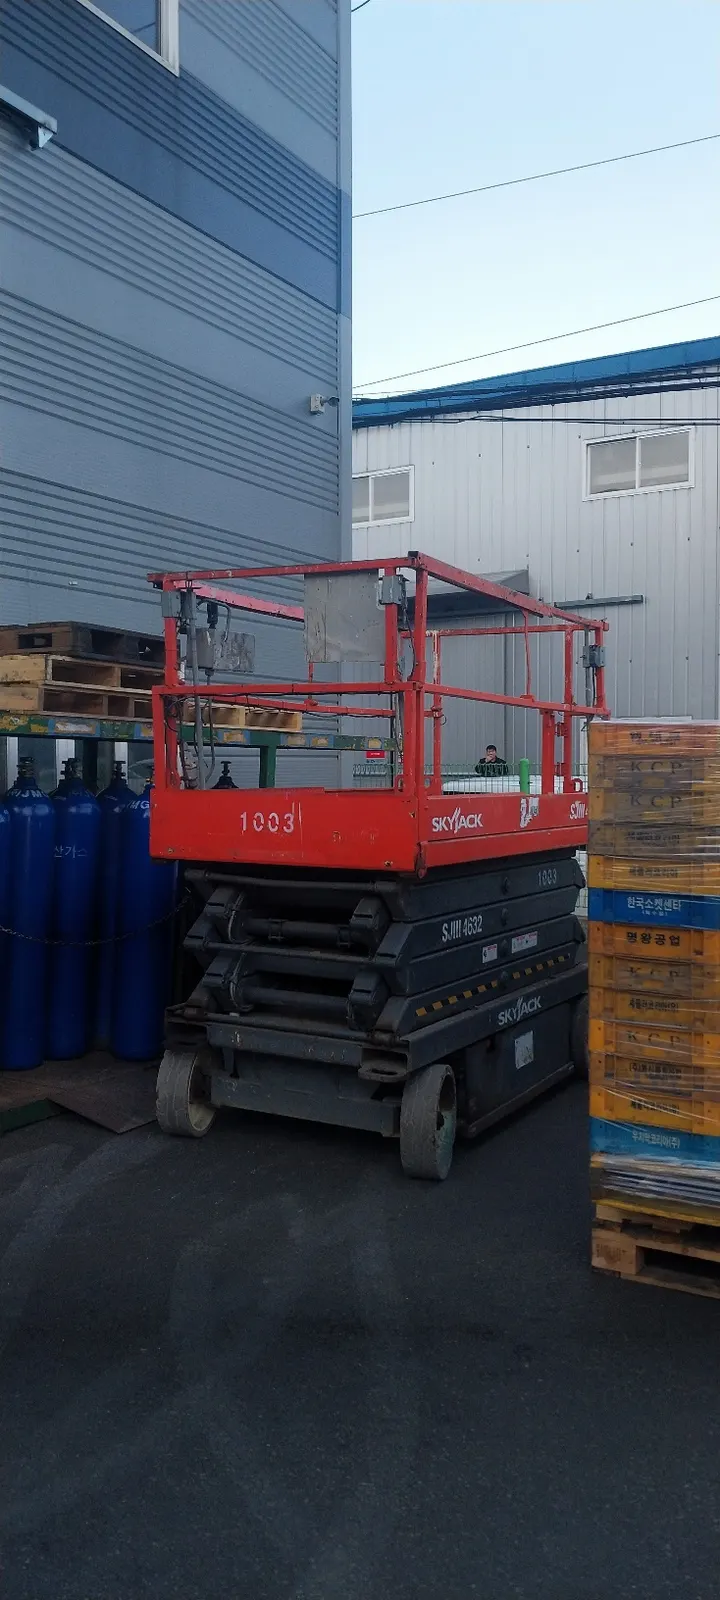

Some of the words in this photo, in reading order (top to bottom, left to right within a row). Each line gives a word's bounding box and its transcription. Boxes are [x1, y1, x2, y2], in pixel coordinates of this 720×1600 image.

[240, 811, 294, 833] 1003
[432, 807, 483, 834] SKYJACK
[538, 868, 557, 887] 1003
[627, 896, 681, 912] 한국소켓센타
[497, 995, 542, 1026] SKYJACK
